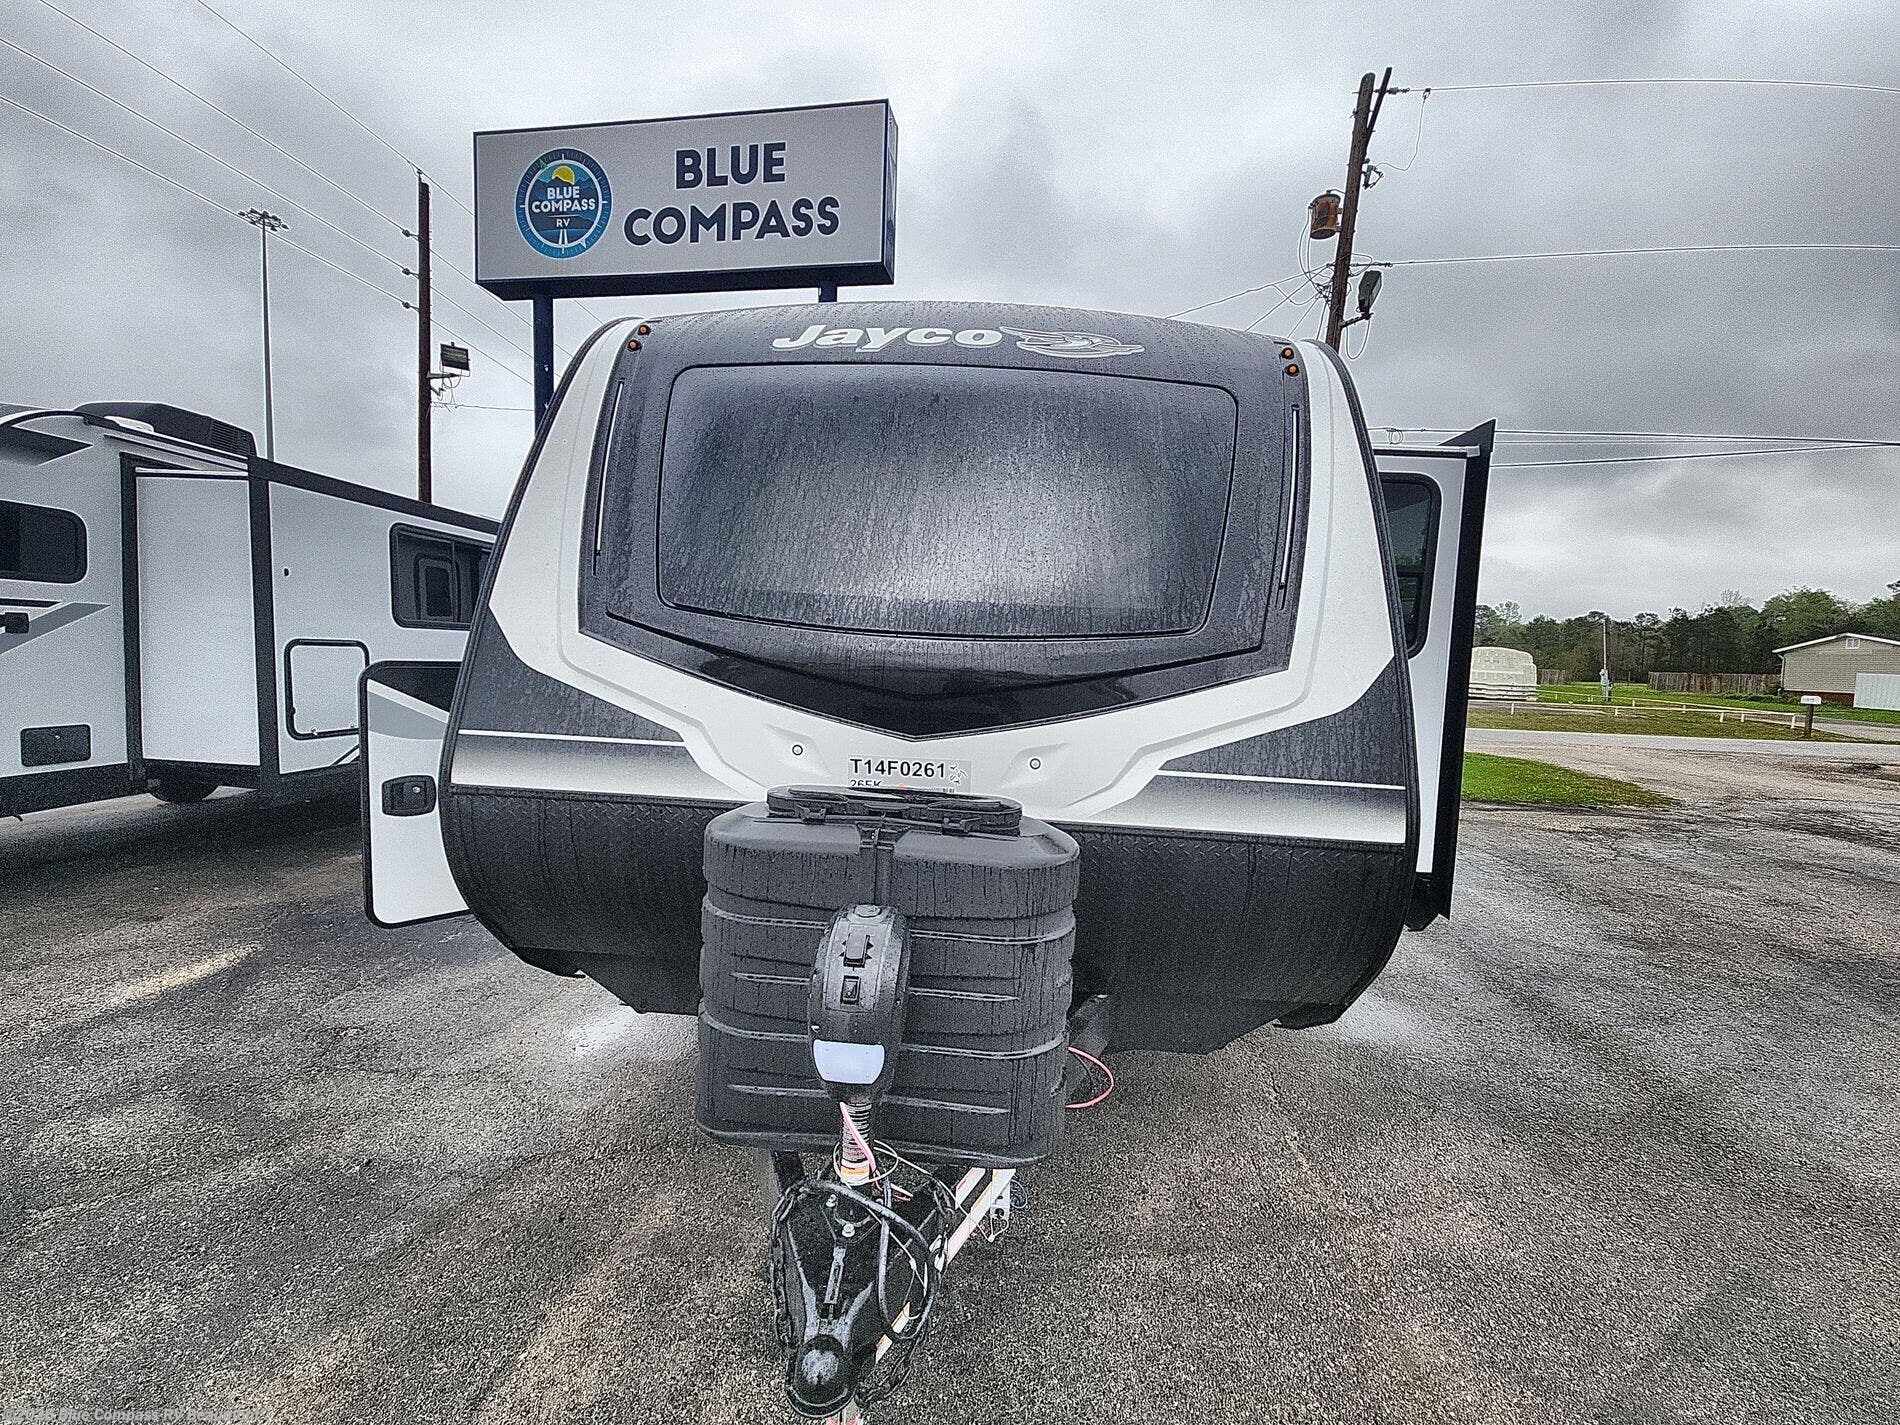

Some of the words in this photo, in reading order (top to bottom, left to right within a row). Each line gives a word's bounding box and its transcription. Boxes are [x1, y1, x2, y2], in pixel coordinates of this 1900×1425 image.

[676, 142, 786, 189] BLUE
[547, 186, 580, 199] BLUE
[531, 199, 596, 213] COMPASS
[556, 218, 570, 228] RV
[624, 196, 839, 245] COMPASS
[772, 325, 1002, 352] Jayco
[849, 758, 945, 778] T14F0261
